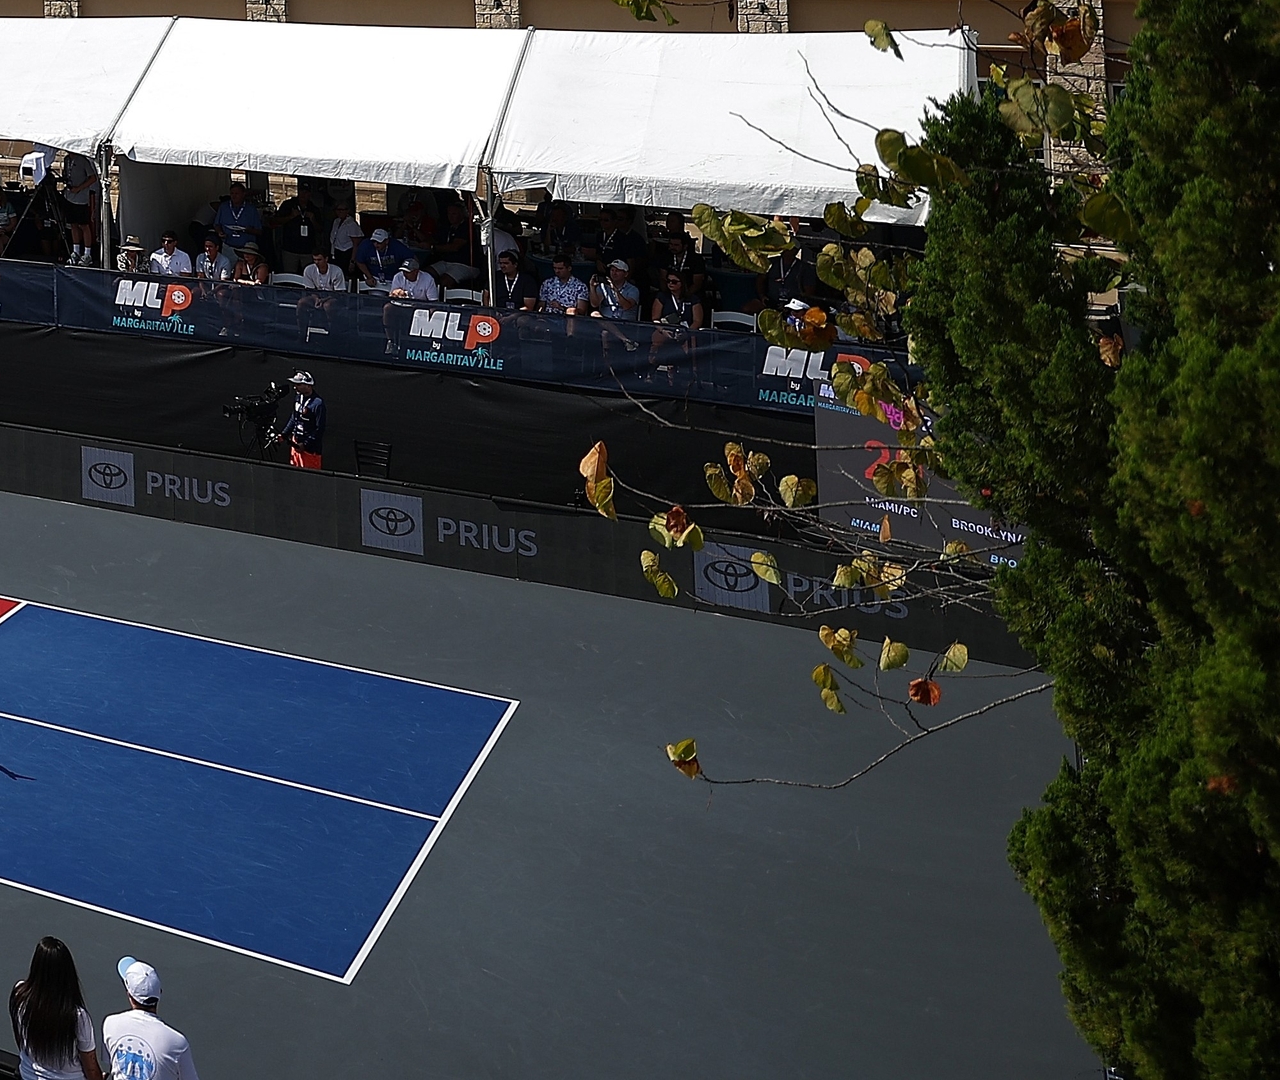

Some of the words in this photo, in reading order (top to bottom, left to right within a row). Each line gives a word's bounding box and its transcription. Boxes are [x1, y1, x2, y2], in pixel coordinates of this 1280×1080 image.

[115, 280, 192, 317] MLP
[112, 314, 196, 336] MARGARITAVILLE
[409, 309, 500, 350] MLP
[405, 347, 504, 371] MARGARITAVILLE
[790, 381, 801, 391] by
[146, 470, 232, 507] PRIUS
[437, 517, 539, 558] PRIUS
[850, 518, 881, 533] MIAM
[952, 518, 1028, 545] BROOKYN/
